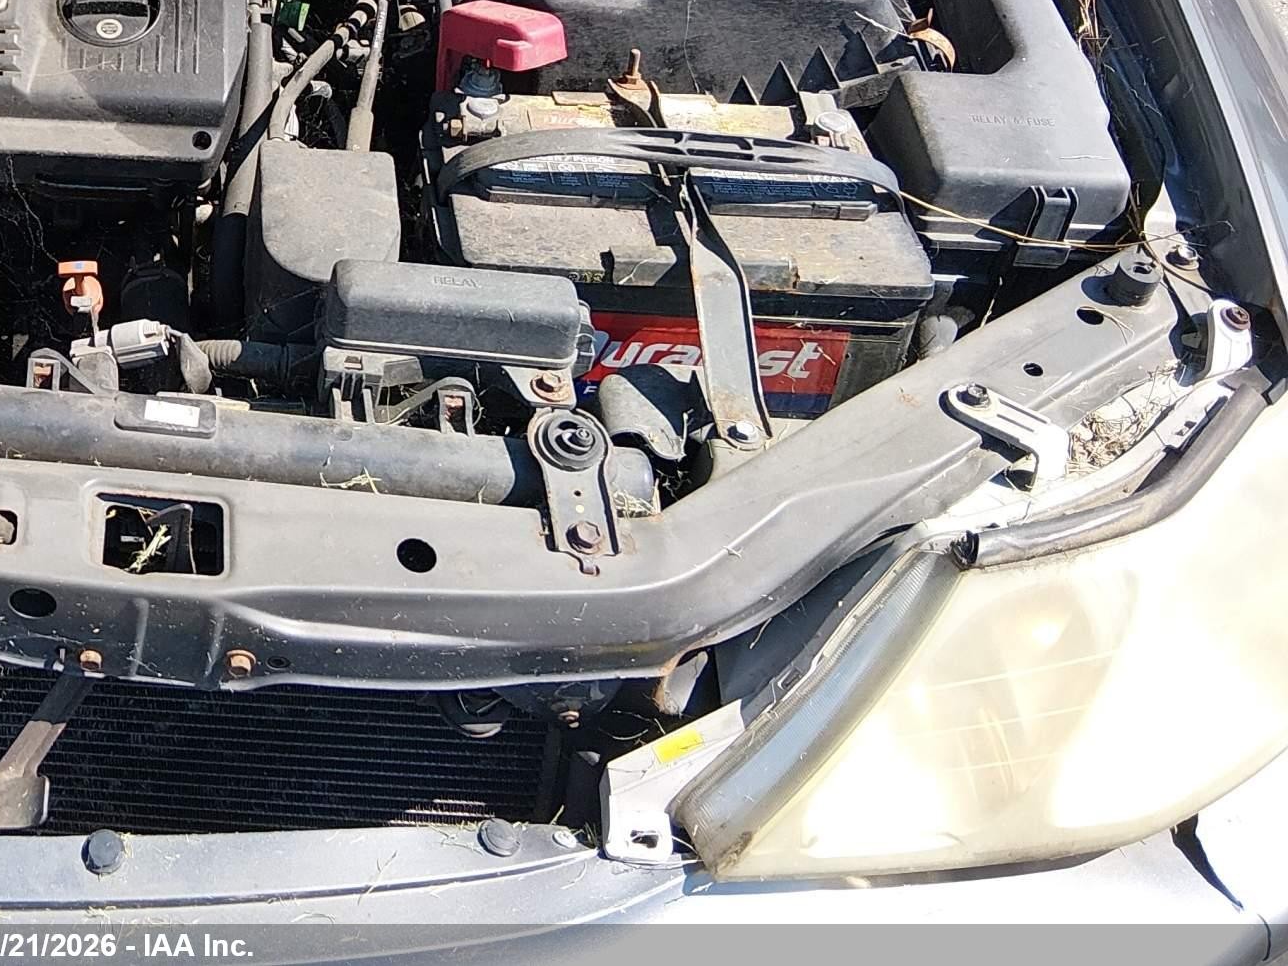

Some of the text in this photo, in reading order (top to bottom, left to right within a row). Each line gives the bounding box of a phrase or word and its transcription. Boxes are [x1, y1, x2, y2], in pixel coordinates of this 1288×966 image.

[968, 114, 1007, 125] RELAY
[1026, 115, 1057, 128] FUSE
[433, 276, 480, 289] RELAY
